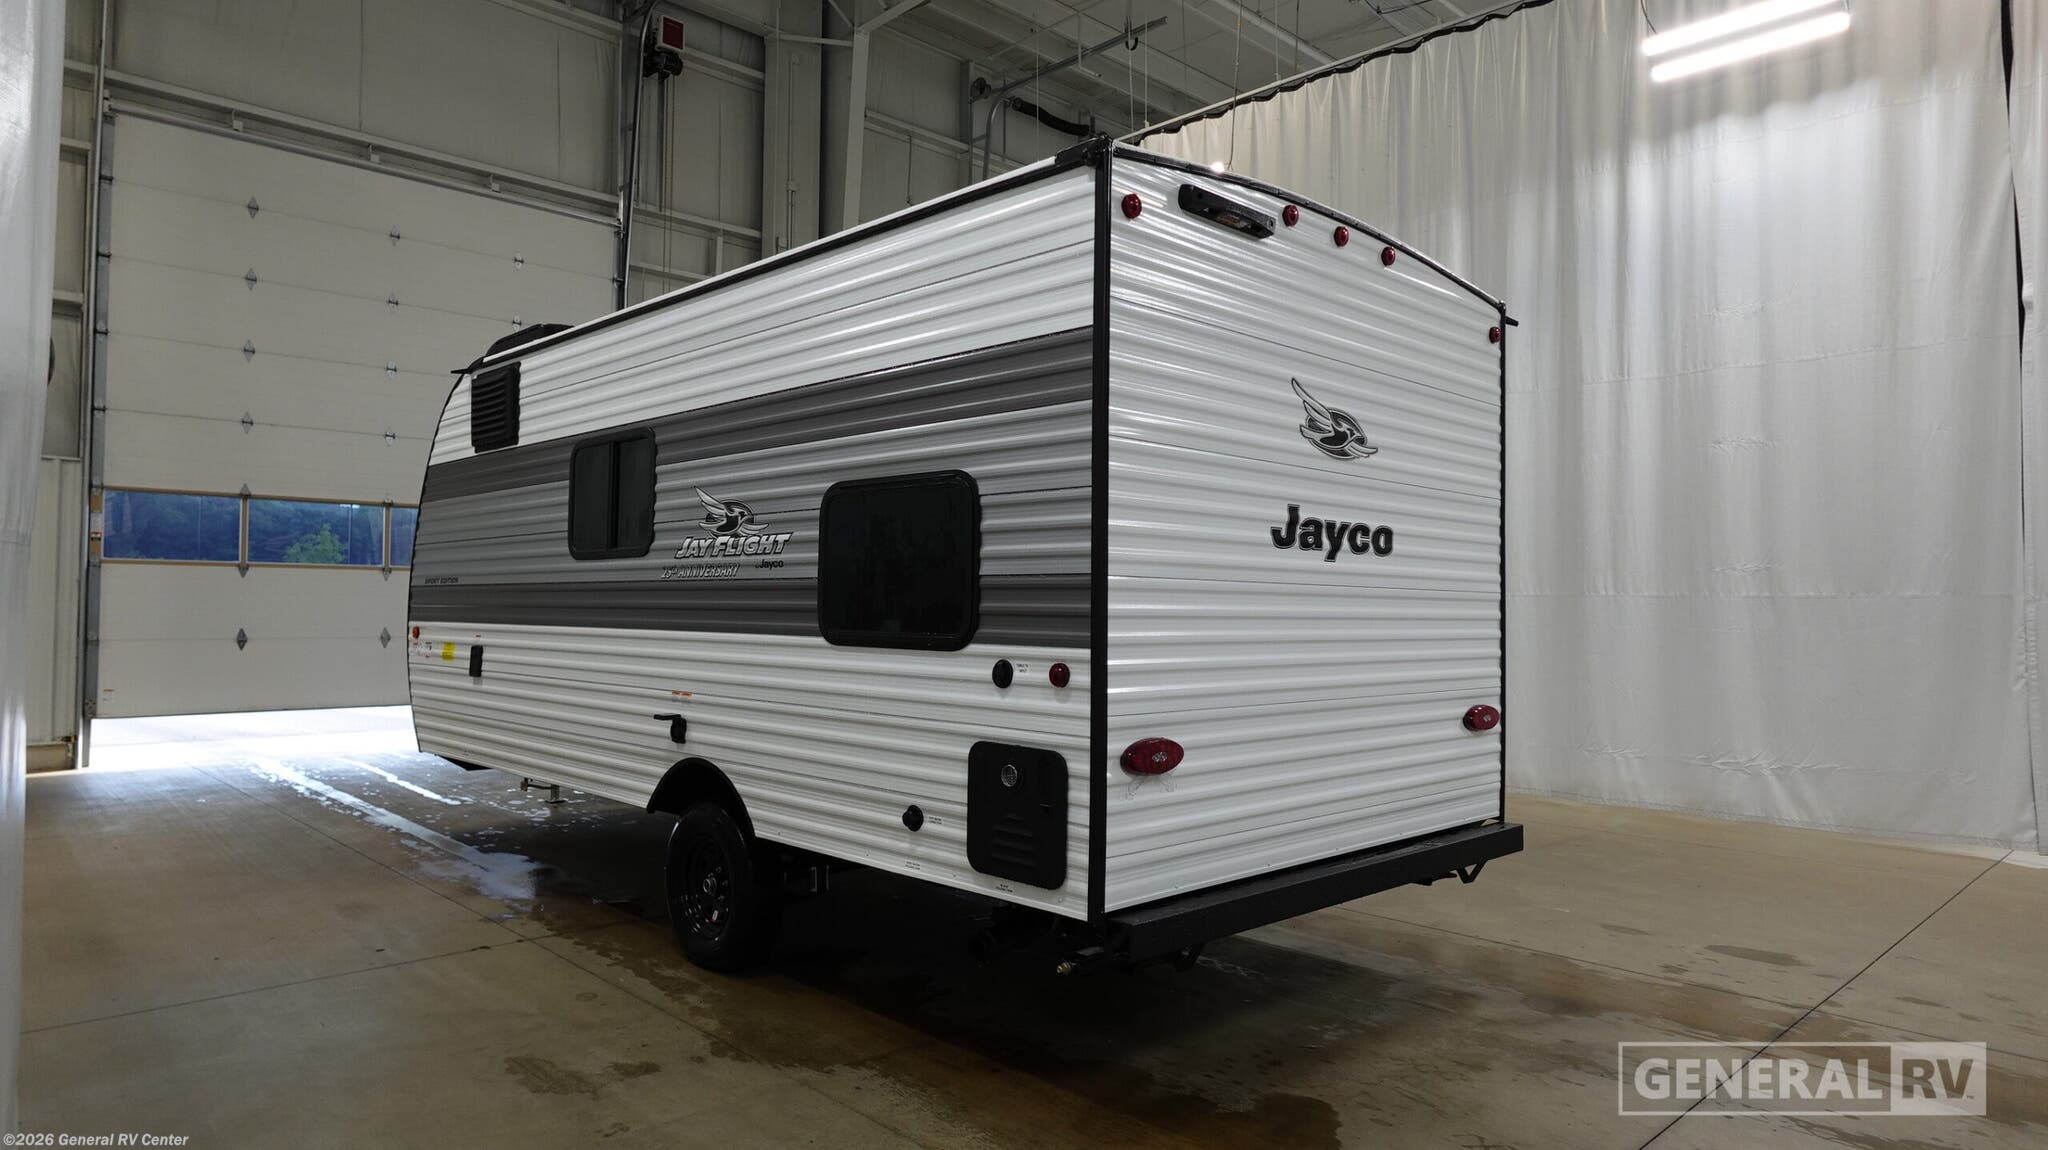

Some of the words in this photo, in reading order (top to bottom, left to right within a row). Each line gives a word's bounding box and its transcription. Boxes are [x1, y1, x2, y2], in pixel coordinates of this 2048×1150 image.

[1270, 503, 1394, 562] Jayco
[676, 537, 713, 558] JAY
[712, 532, 792, 556] FLIGHT
[679, 563, 740, 577] ANNIVERSARY
[760, 559, 784, 570] Jayco
